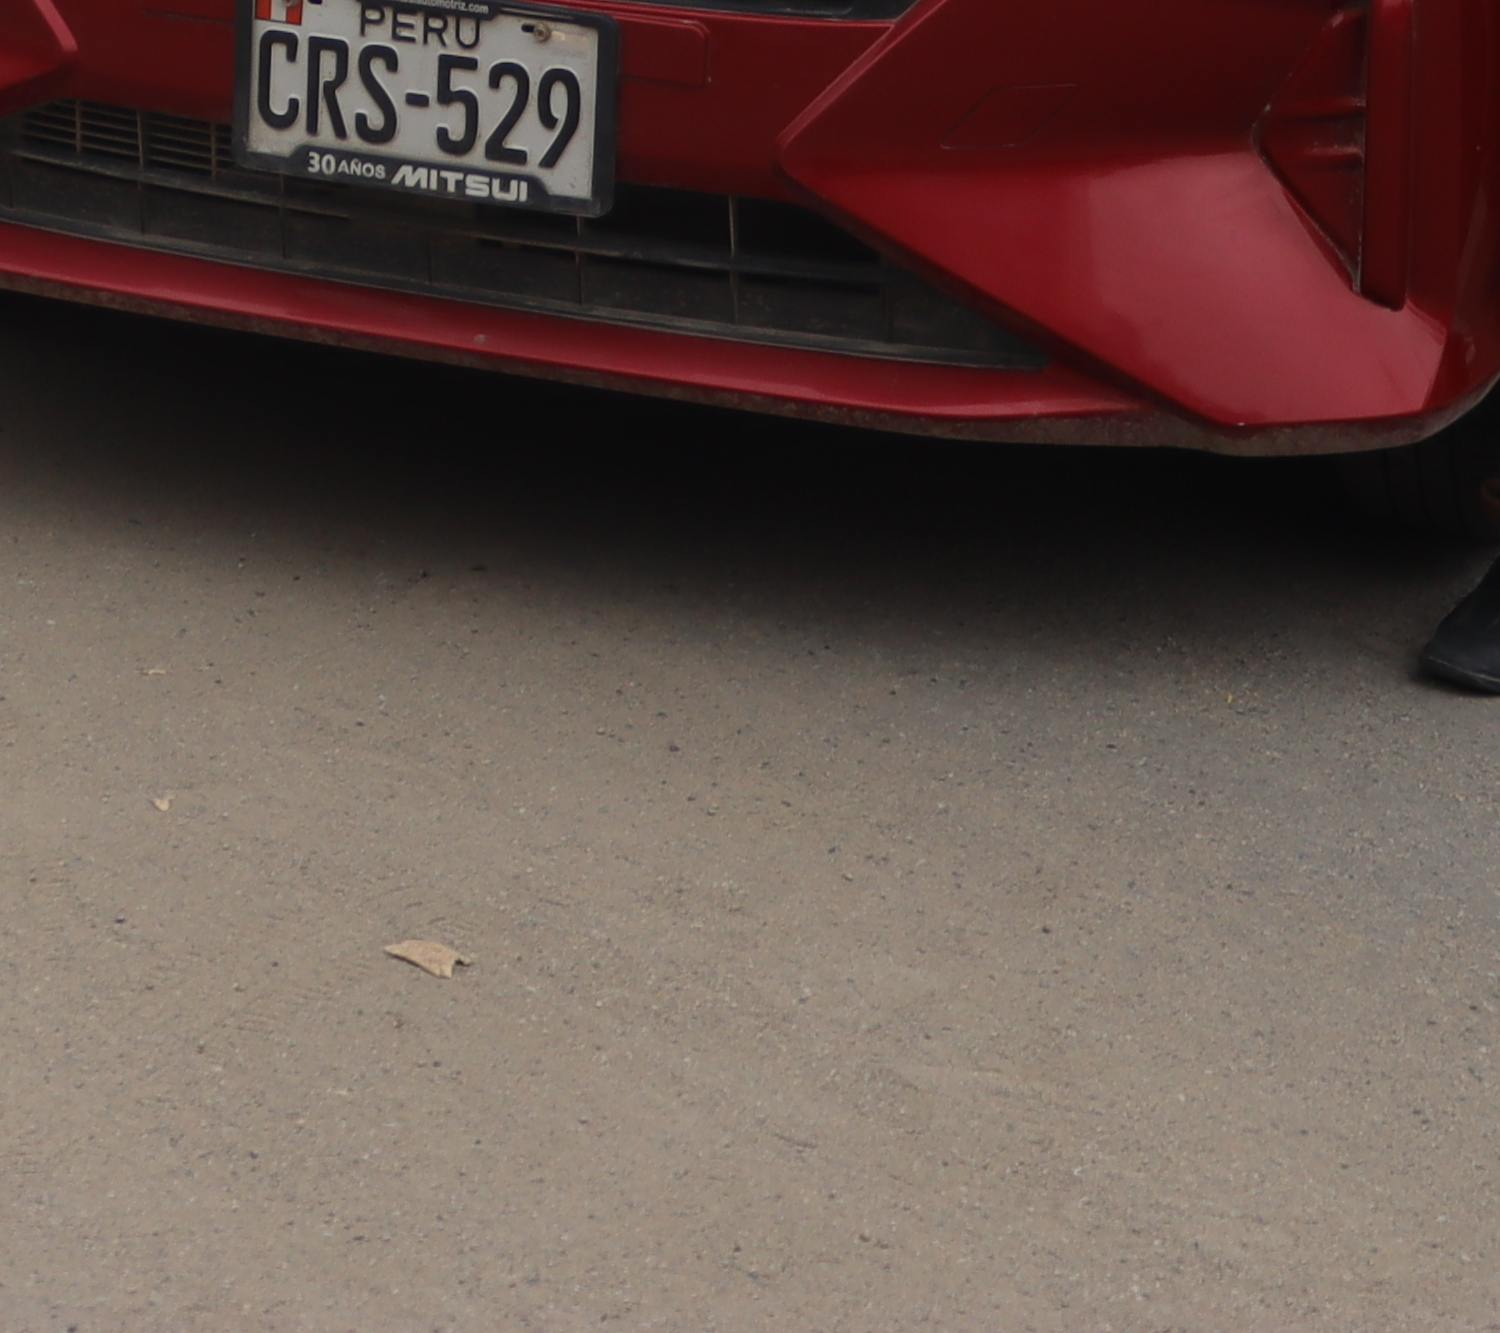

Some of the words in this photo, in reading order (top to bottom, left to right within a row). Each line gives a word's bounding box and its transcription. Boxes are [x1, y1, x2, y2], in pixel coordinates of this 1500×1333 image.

[359, 5, 482, 50] PERU
[257, 29, 582, 170] CRS-529
[307, 151, 337, 176] 30
[337, 158, 386, 180] AÑOS
[390, 164, 529, 203] MITSUI
